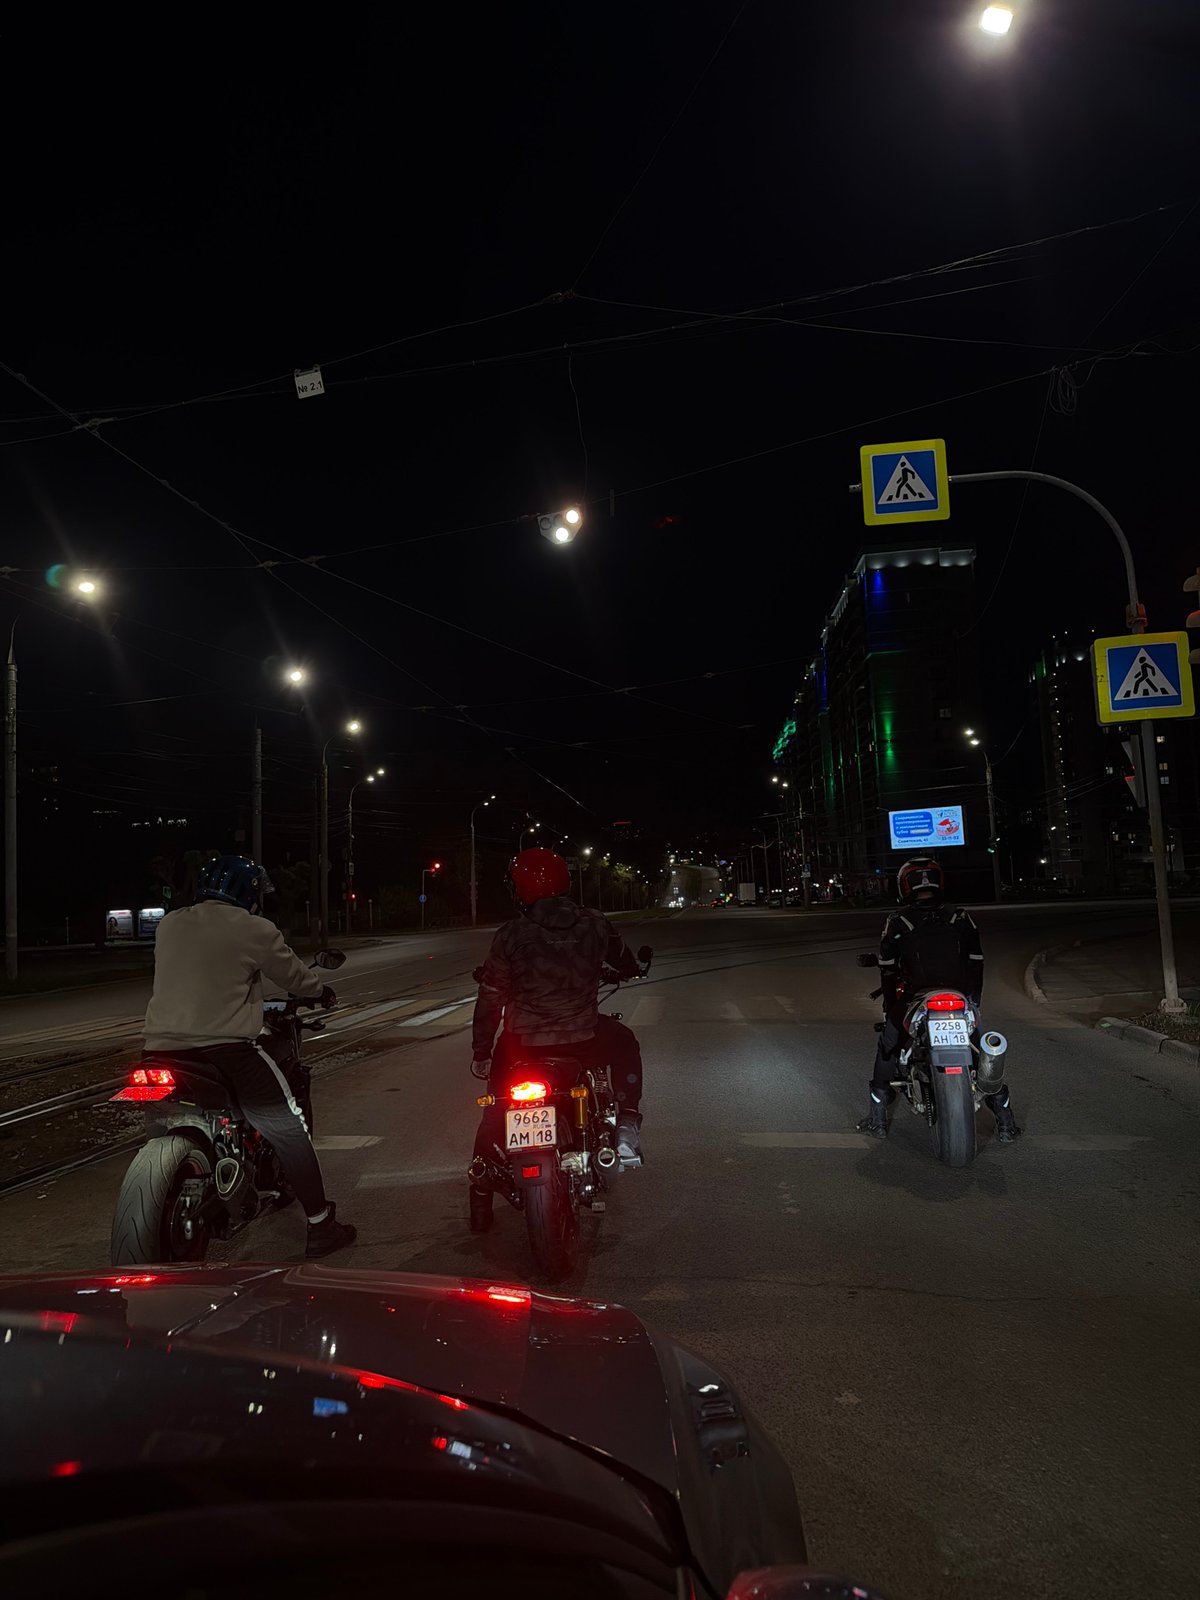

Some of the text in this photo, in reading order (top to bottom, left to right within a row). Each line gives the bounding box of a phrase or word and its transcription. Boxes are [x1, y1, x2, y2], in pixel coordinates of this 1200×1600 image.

[298, 381, 322, 393] № 2.1
[934, 1022, 962, 1031] 2258
[953, 1035, 966, 1044] 18
[514, 1110, 549, 1125] 9662
[536, 1129, 553, 1143] 18
